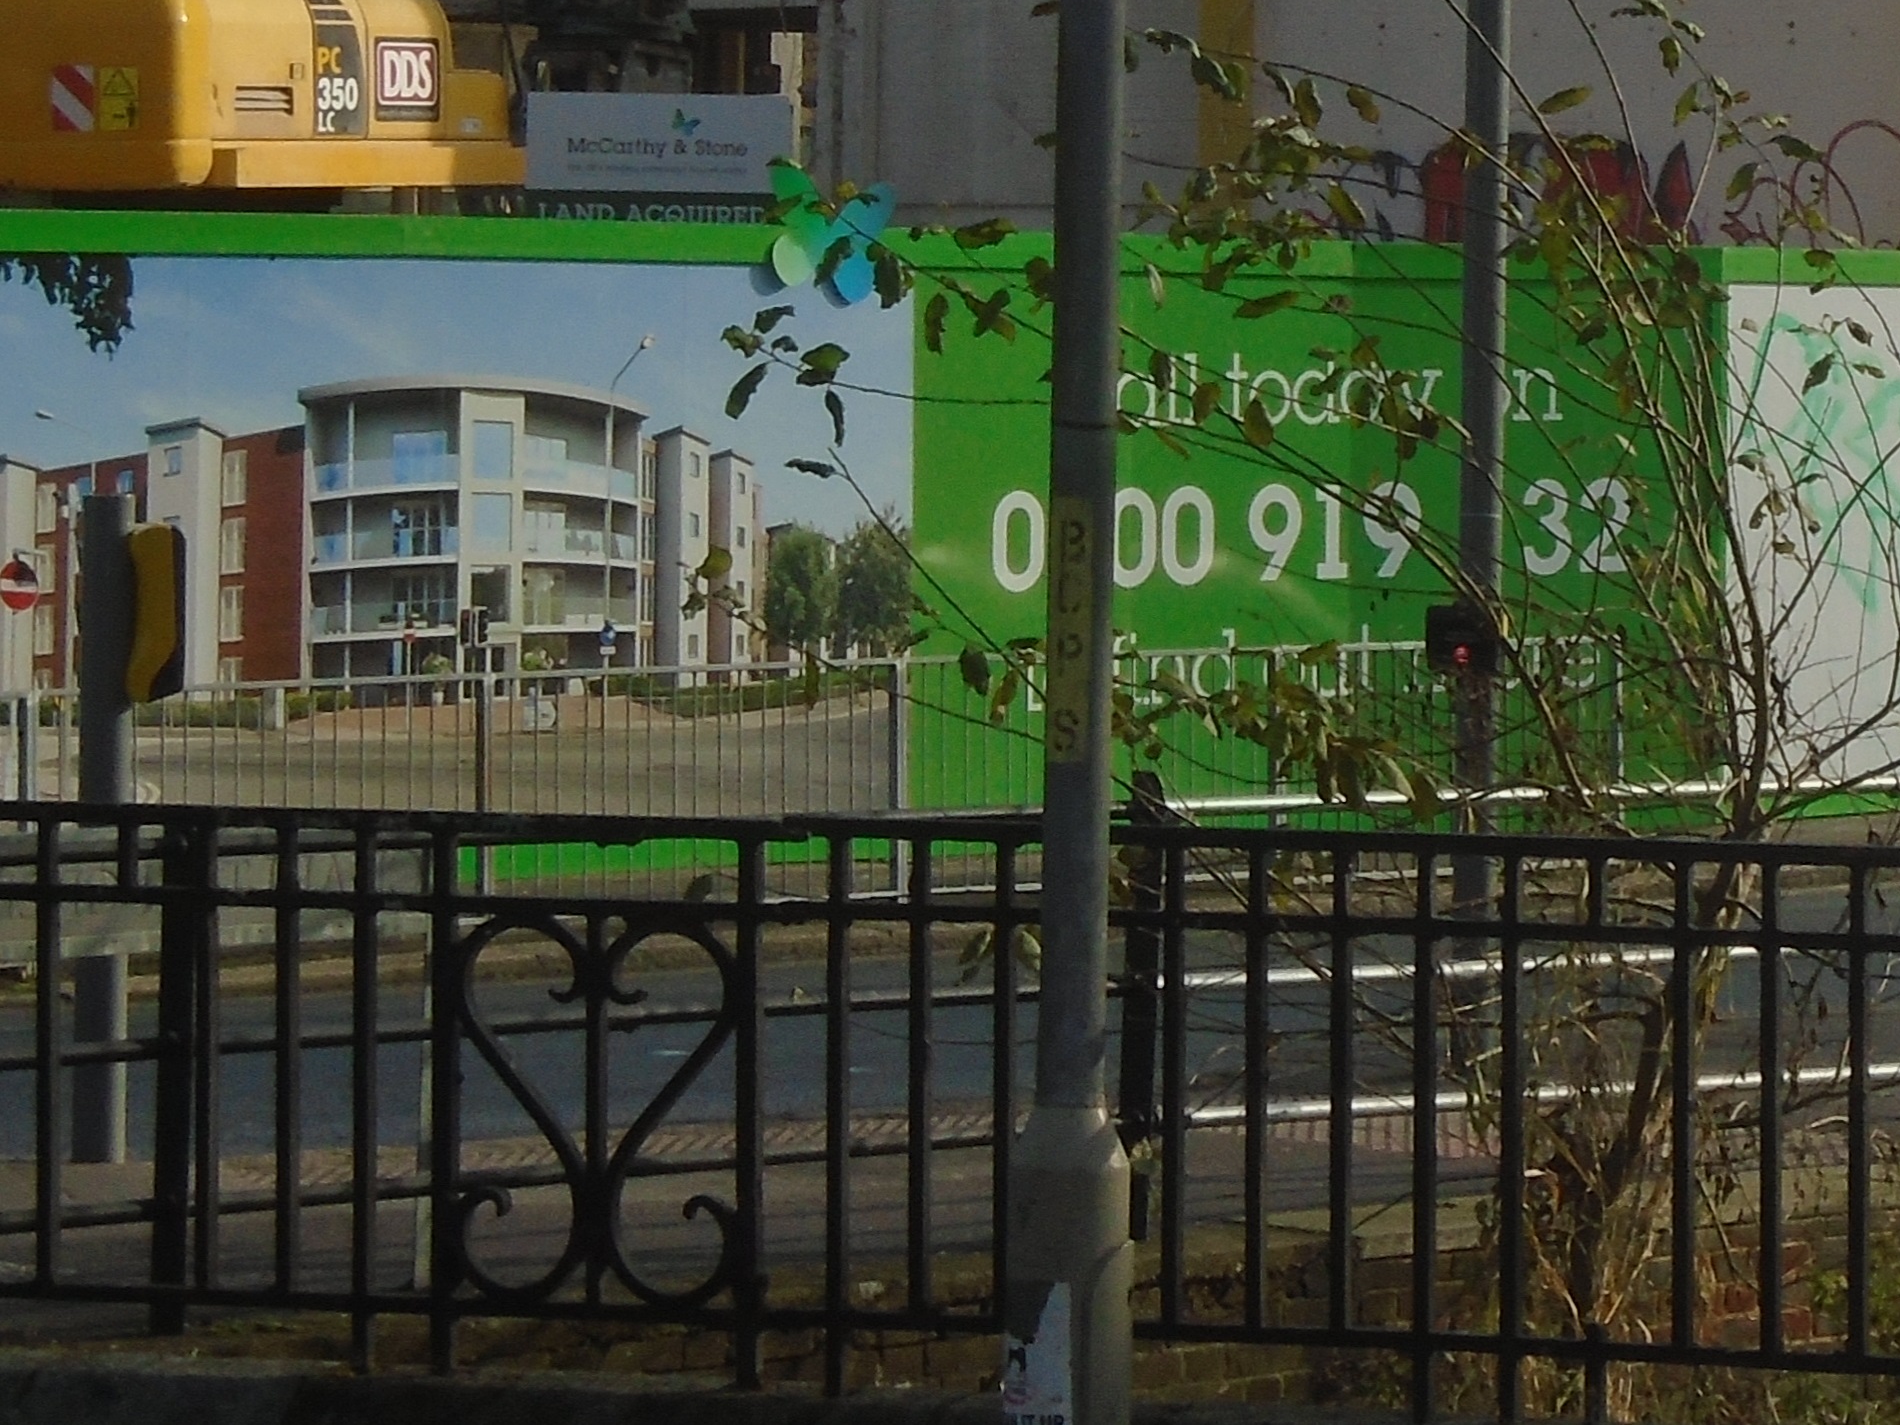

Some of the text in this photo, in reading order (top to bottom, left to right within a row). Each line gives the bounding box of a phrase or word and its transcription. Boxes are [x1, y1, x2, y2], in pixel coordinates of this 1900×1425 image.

[316, 46, 342, 74] PC
[383, 49, 432, 99] DDS
[317, 77, 359, 111] 350
[317, 111, 335, 132] LC
[567, 137, 748, 159] McCarthy & Stone
[538, 201, 616, 221] LAND
[1116, 353, 1198, 428] all
[992, 478, 1631, 592] 000 919 32
